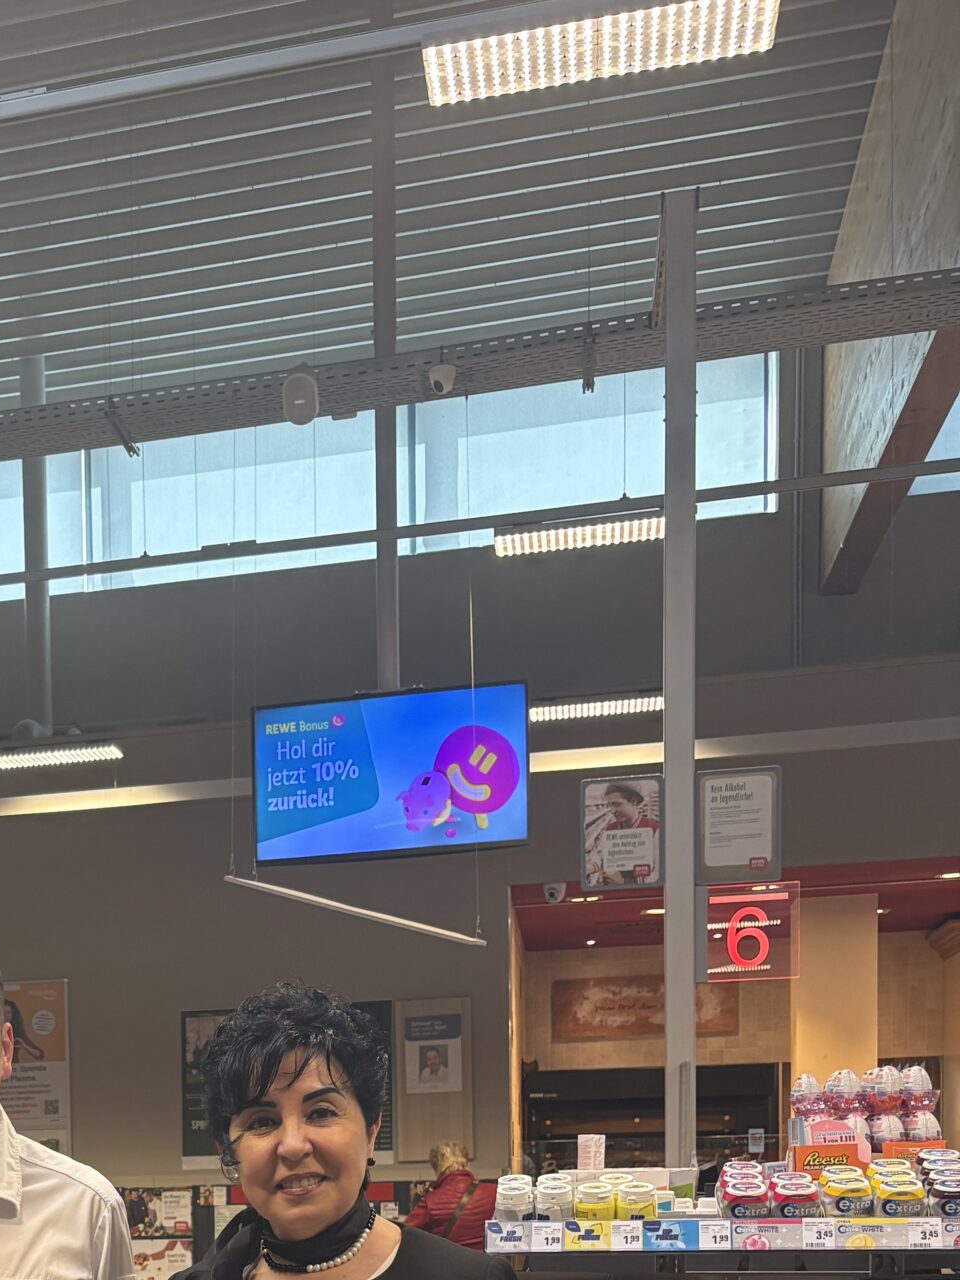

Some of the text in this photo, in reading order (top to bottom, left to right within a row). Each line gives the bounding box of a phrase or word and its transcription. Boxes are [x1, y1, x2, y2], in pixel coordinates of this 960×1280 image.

[266, 720, 329, 735] REWE Bonus
[277, 737, 336, 761] Hol dir
[267, 758, 359, 791] jetzt 10%
[268, 787, 335, 812] zurück!
[726, 906, 770, 967] 6
[803, 1150, 849, 1166] Reese's
[758, 1226, 780, 1234] WHITE
[862, 1226, 884, 1234] WHITE
[499, 1235, 522, 1243] FRESH
[577, 1234, 601, 1242] FRESH
[655, 1234, 679, 1242] FRESH
